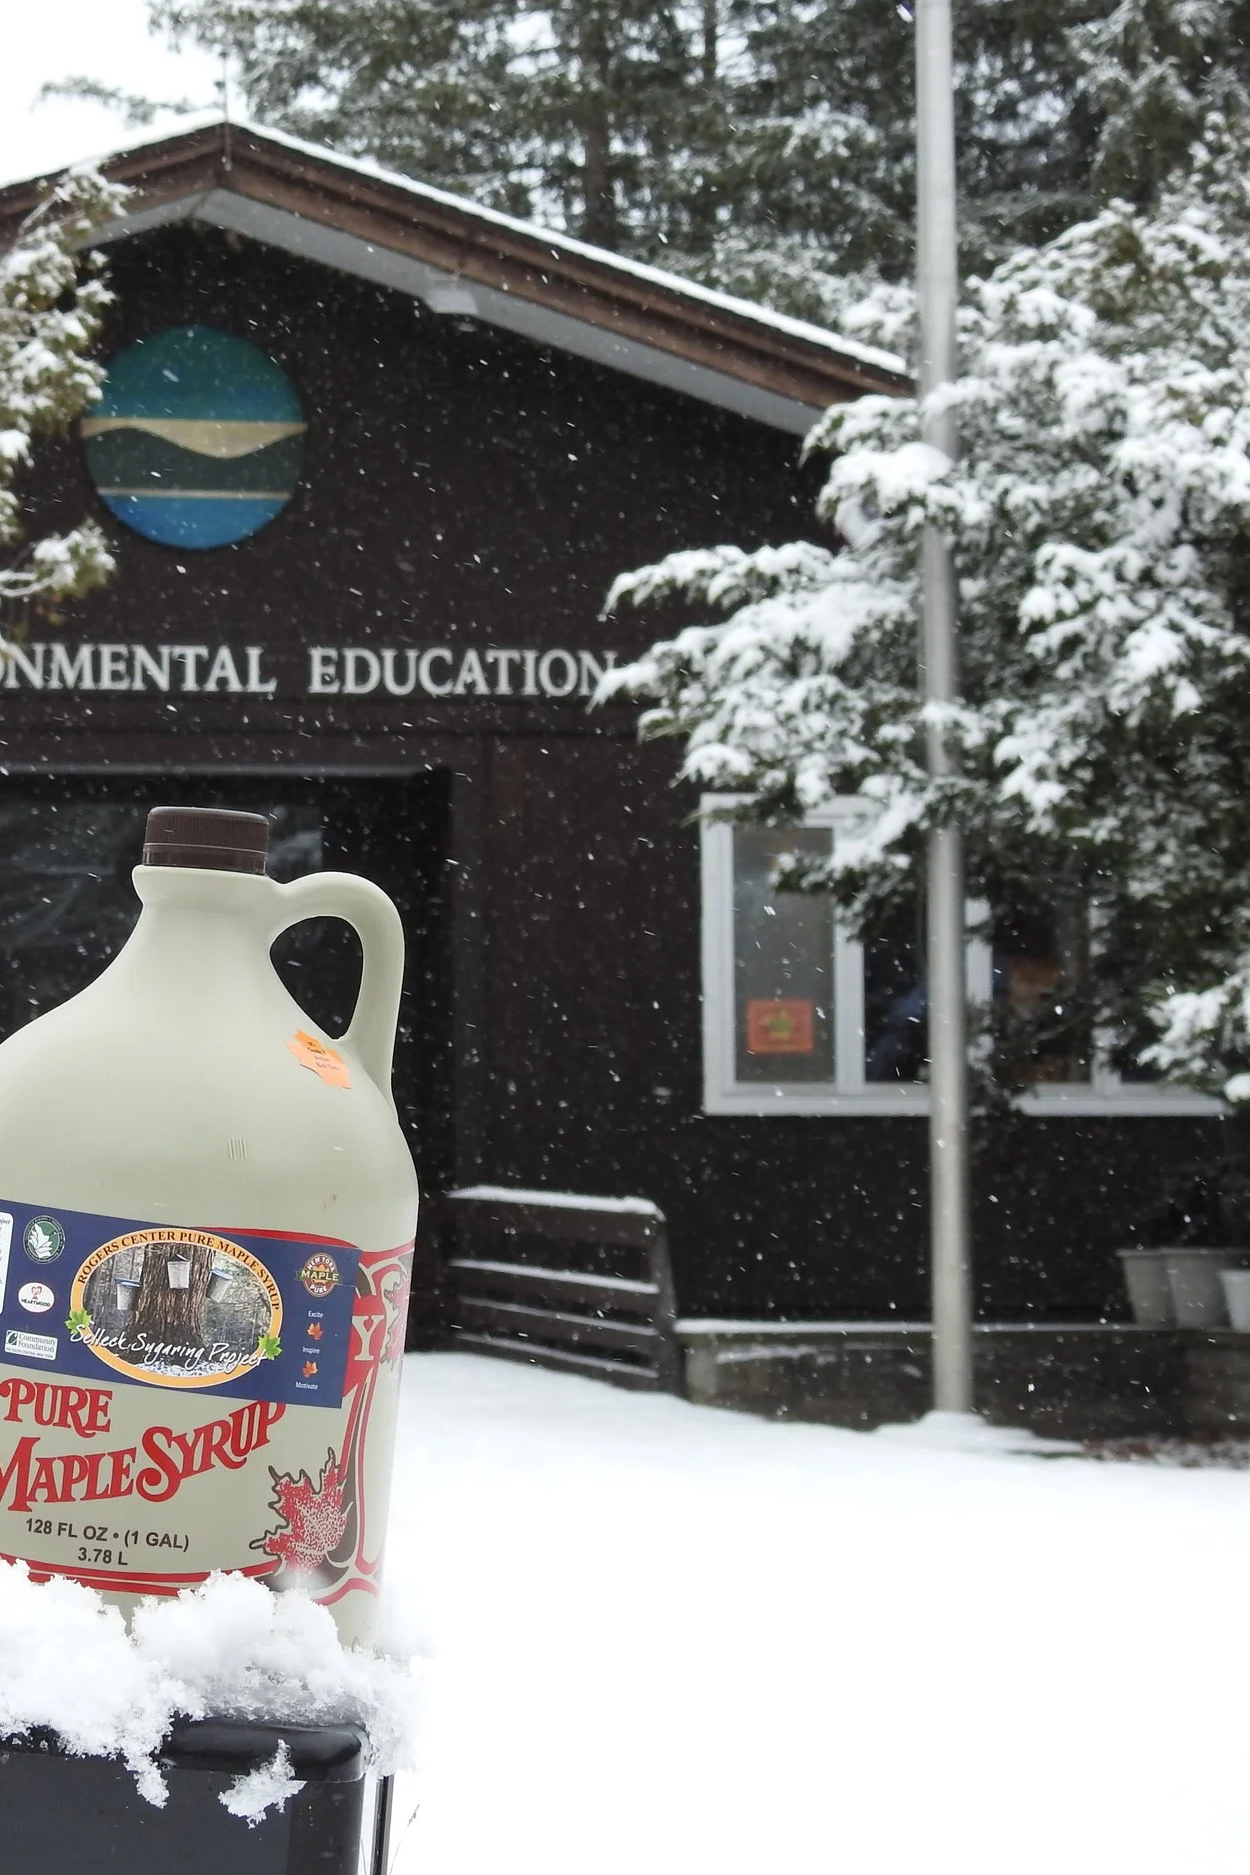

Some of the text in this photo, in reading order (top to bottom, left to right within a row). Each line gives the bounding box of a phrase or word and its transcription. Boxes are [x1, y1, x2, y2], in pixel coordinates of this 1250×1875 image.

[307, 646, 618, 698] EDUCATION
[78, 1231, 281, 1311] ROGERS CENTER PURE MAPLE SYRUP
[307, 1256, 335, 1272] NEW YORK
[301, 1270, 339, 1281] MAPLE
[310, 1284, 327, 1293] PURE
[308, 1310, 324, 1319] Excite
[18, 1341, 55, 1353] Foundation
[19, 1333, 56, 1347] Community
[70, 1322, 269, 1375] Selleck Sugaring Project
[302, 1346, 320, 1354] Inspire
[295, 1381, 319, 1390] Motivate
[136, 1401, 287, 1503] SYRUP
[25, 1517, 190, 1551] 128 FL OZ (1 GAL)
[77, 1547, 128, 1566] 3.78 L
